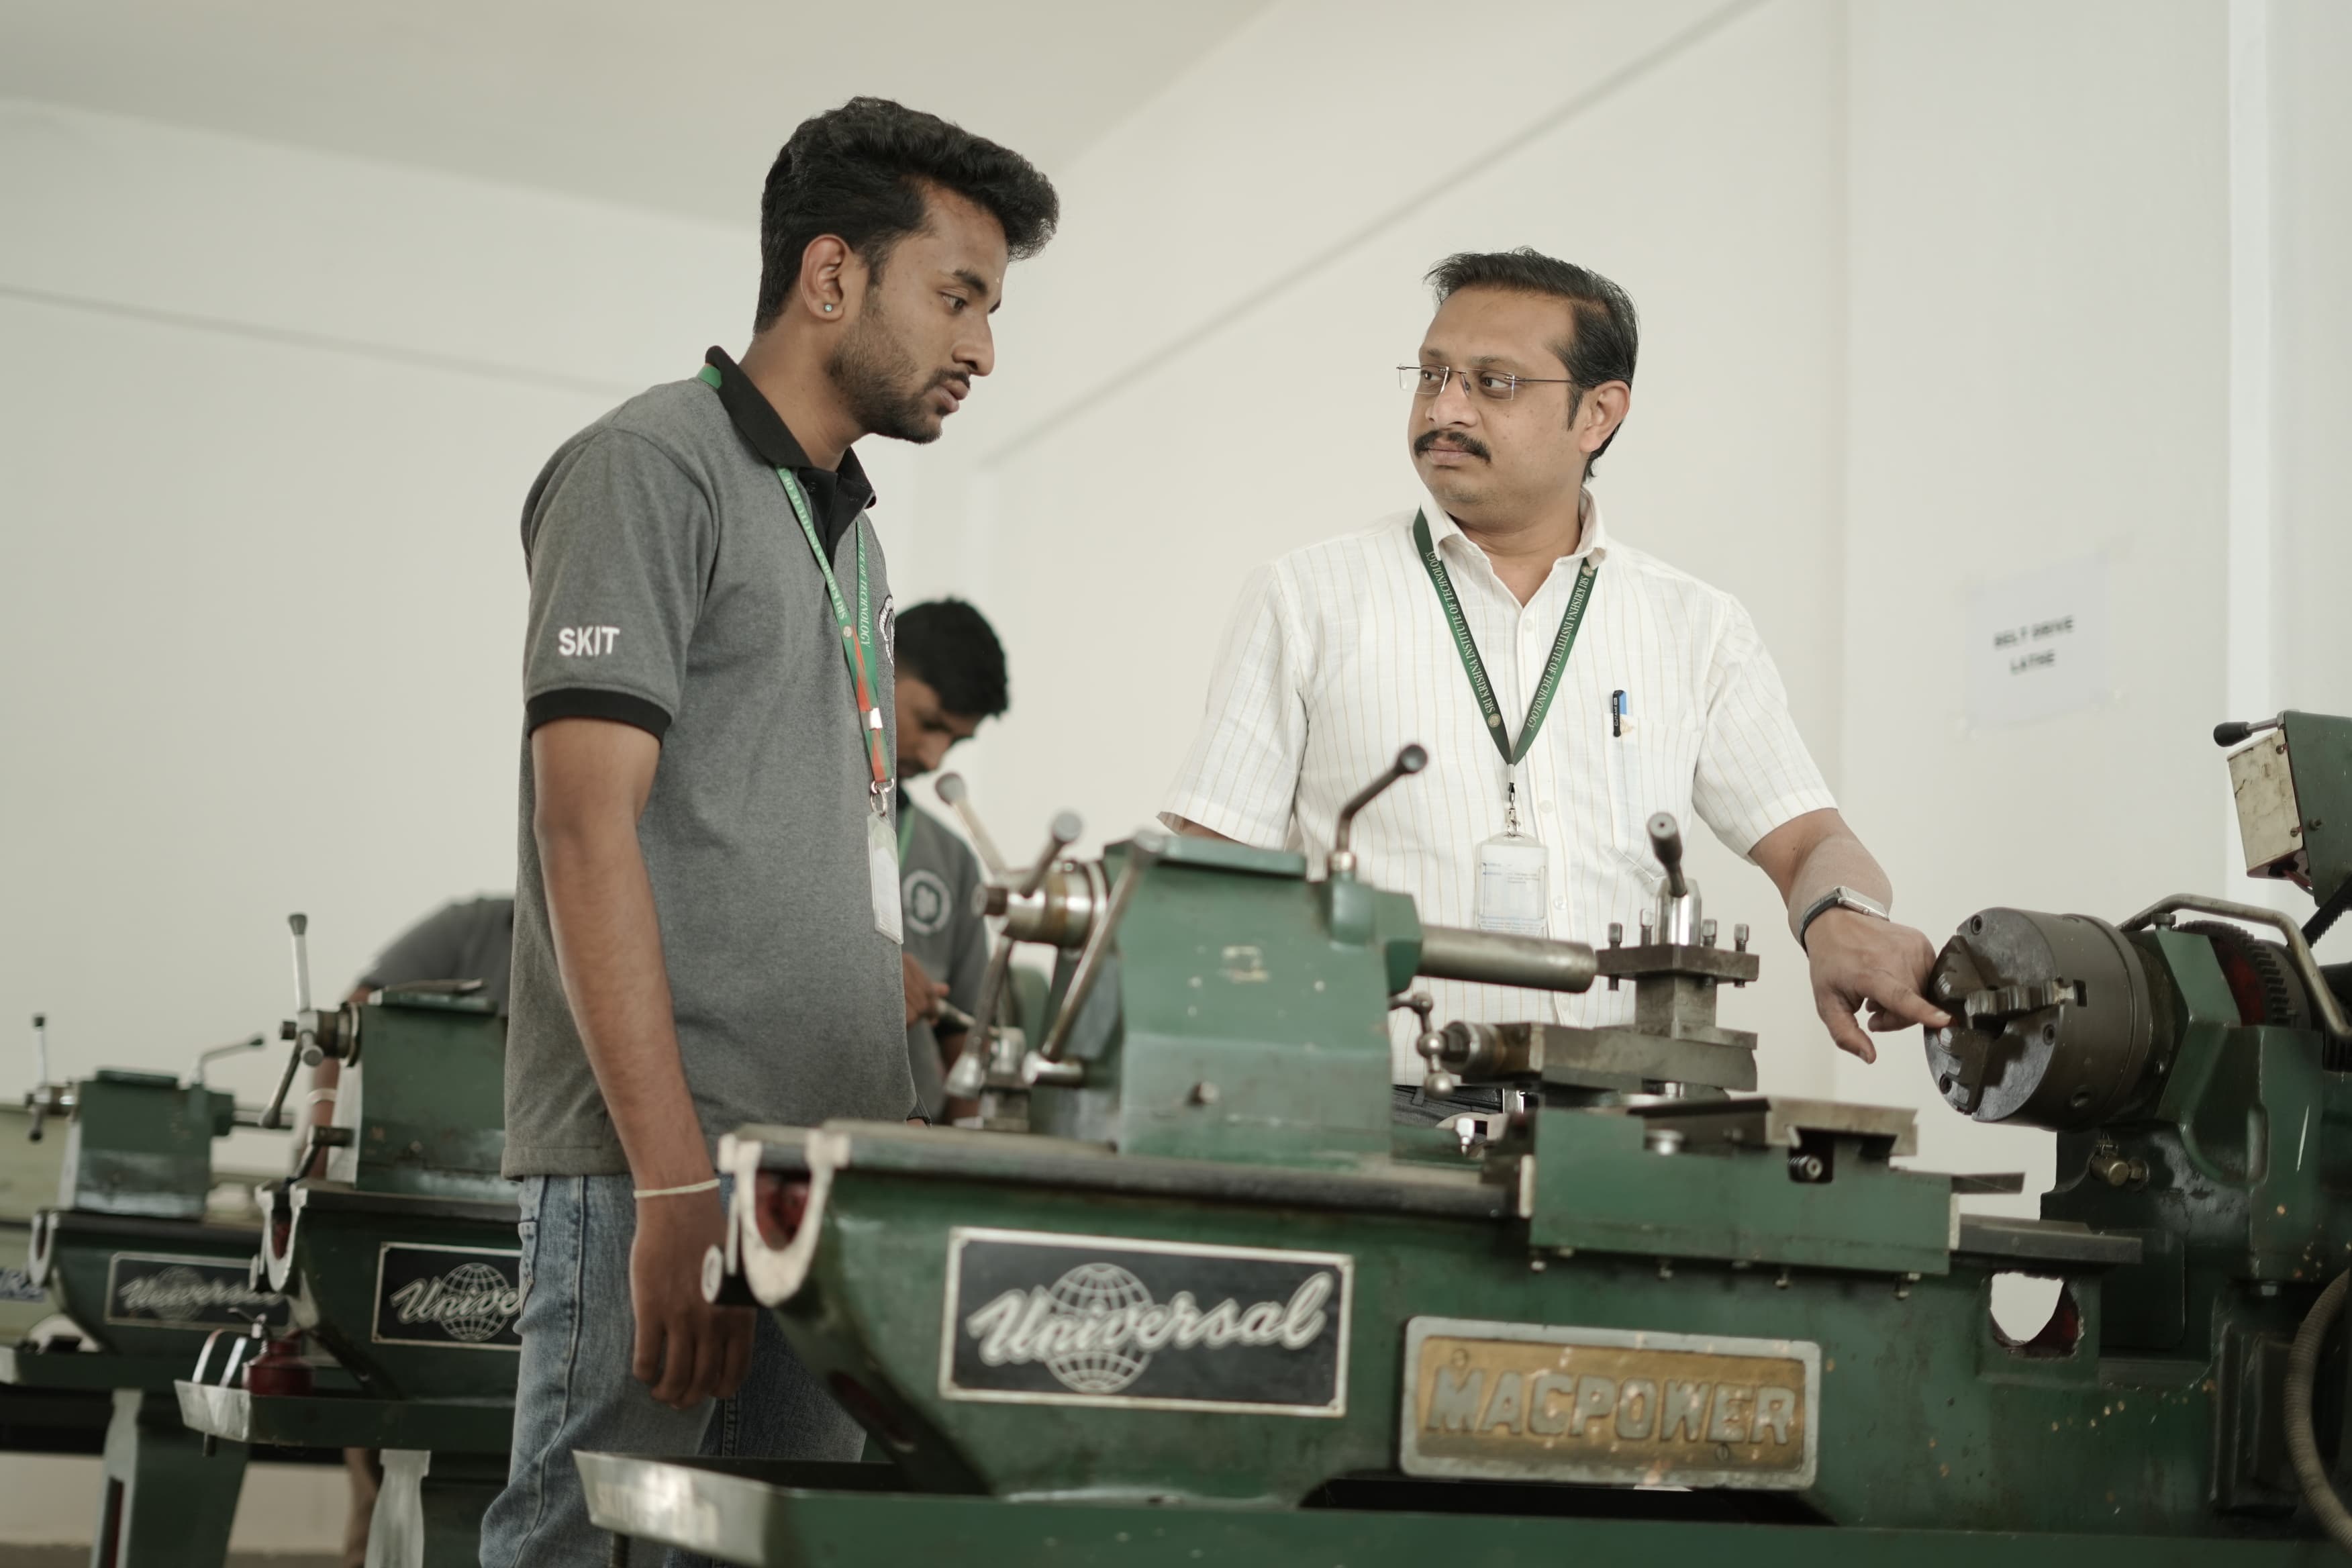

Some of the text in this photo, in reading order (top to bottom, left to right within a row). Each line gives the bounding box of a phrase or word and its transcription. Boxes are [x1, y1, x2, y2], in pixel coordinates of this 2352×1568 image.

[558, 626, 620, 656] SKIT
[836, 601, 847, 620] SRI
[860, 579, 871, 648] TECHNOLOGY
[1425, 550, 1496, 714] SRI KRISHNA INSTITUTE OF TECHNOLOGY
[1527, 576, 1589, 730] SRI KRISHNA INSTITUTE OF TECHNOLOGY
[390, 1275, 520, 1325] Unive
[966, 1271, 1334, 1367] Universal
